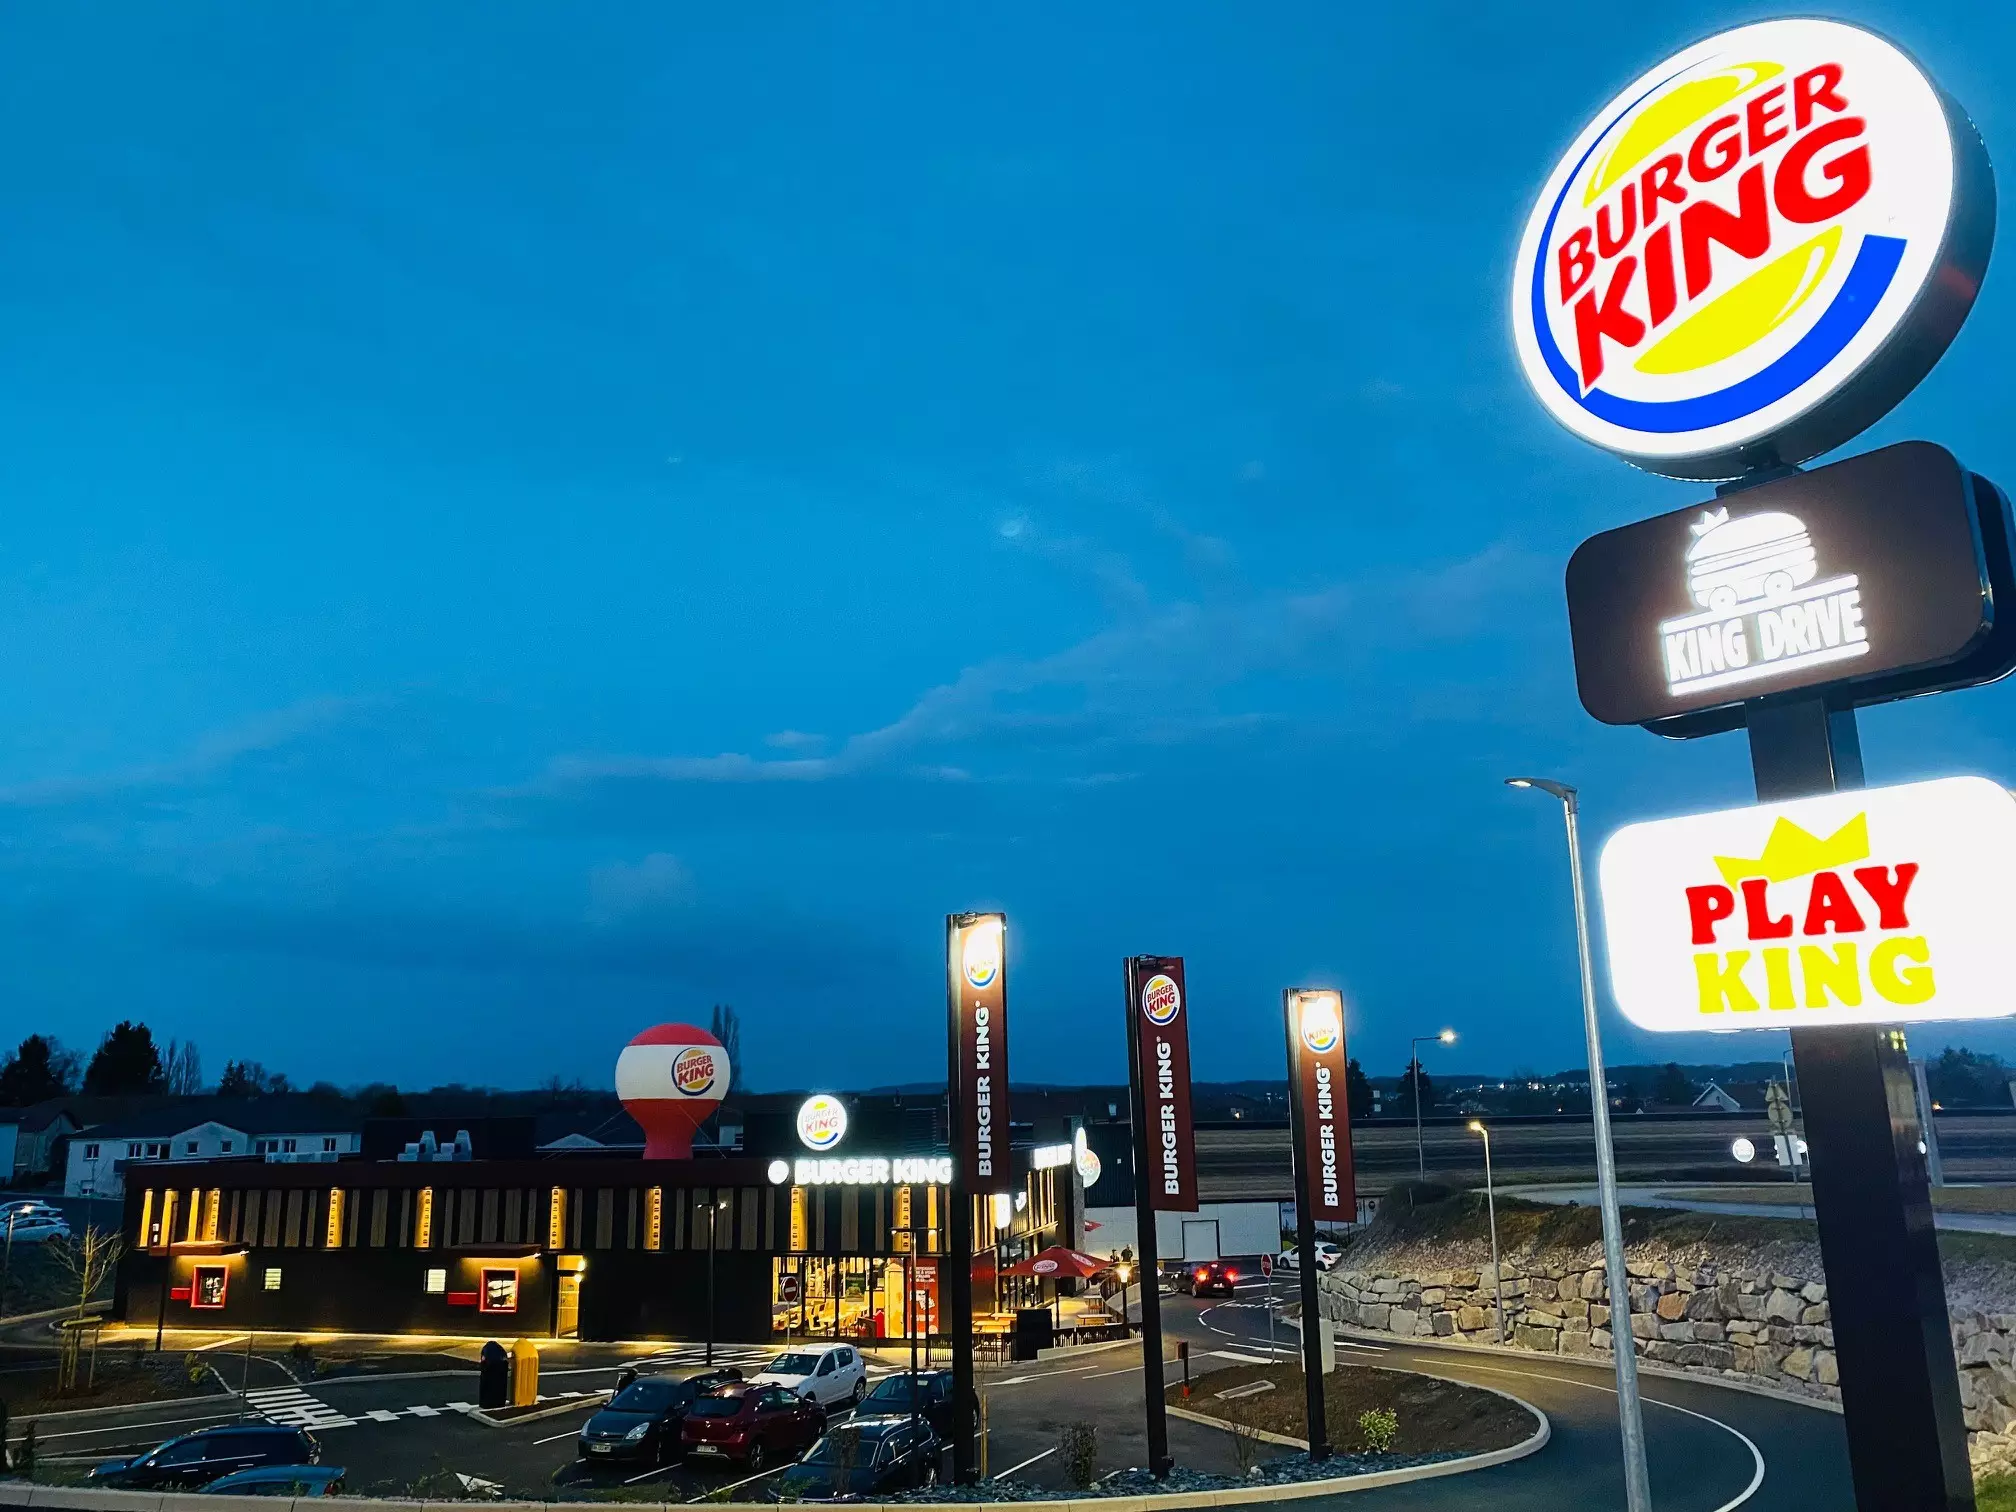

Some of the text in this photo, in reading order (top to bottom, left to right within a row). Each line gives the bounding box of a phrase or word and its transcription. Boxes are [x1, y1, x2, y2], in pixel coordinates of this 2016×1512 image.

[1558, 62, 1849, 306] BURGER
[1574, 116, 1873, 389] KING
[1665, 589, 1868, 681] KING DRIVE
[1685, 862, 1919, 945] PLAY
[1147, 984, 1174, 1003] BURGER
[1149, 992, 1176, 1014] KING
[1693, 935, 1937, 1014] KING
[676, 1055, 712, 1074] BURGER
[678, 1064, 714, 1088] KING
[975, 1006, 992, 1176] BURGER KING
[805, 1116, 839, 1135] KING
[1156, 1042, 1180, 1195] BURGER KING
[1316, 1067, 1339, 1207] BURGER KING
[794, 1158, 952, 1185] BURGER KING
